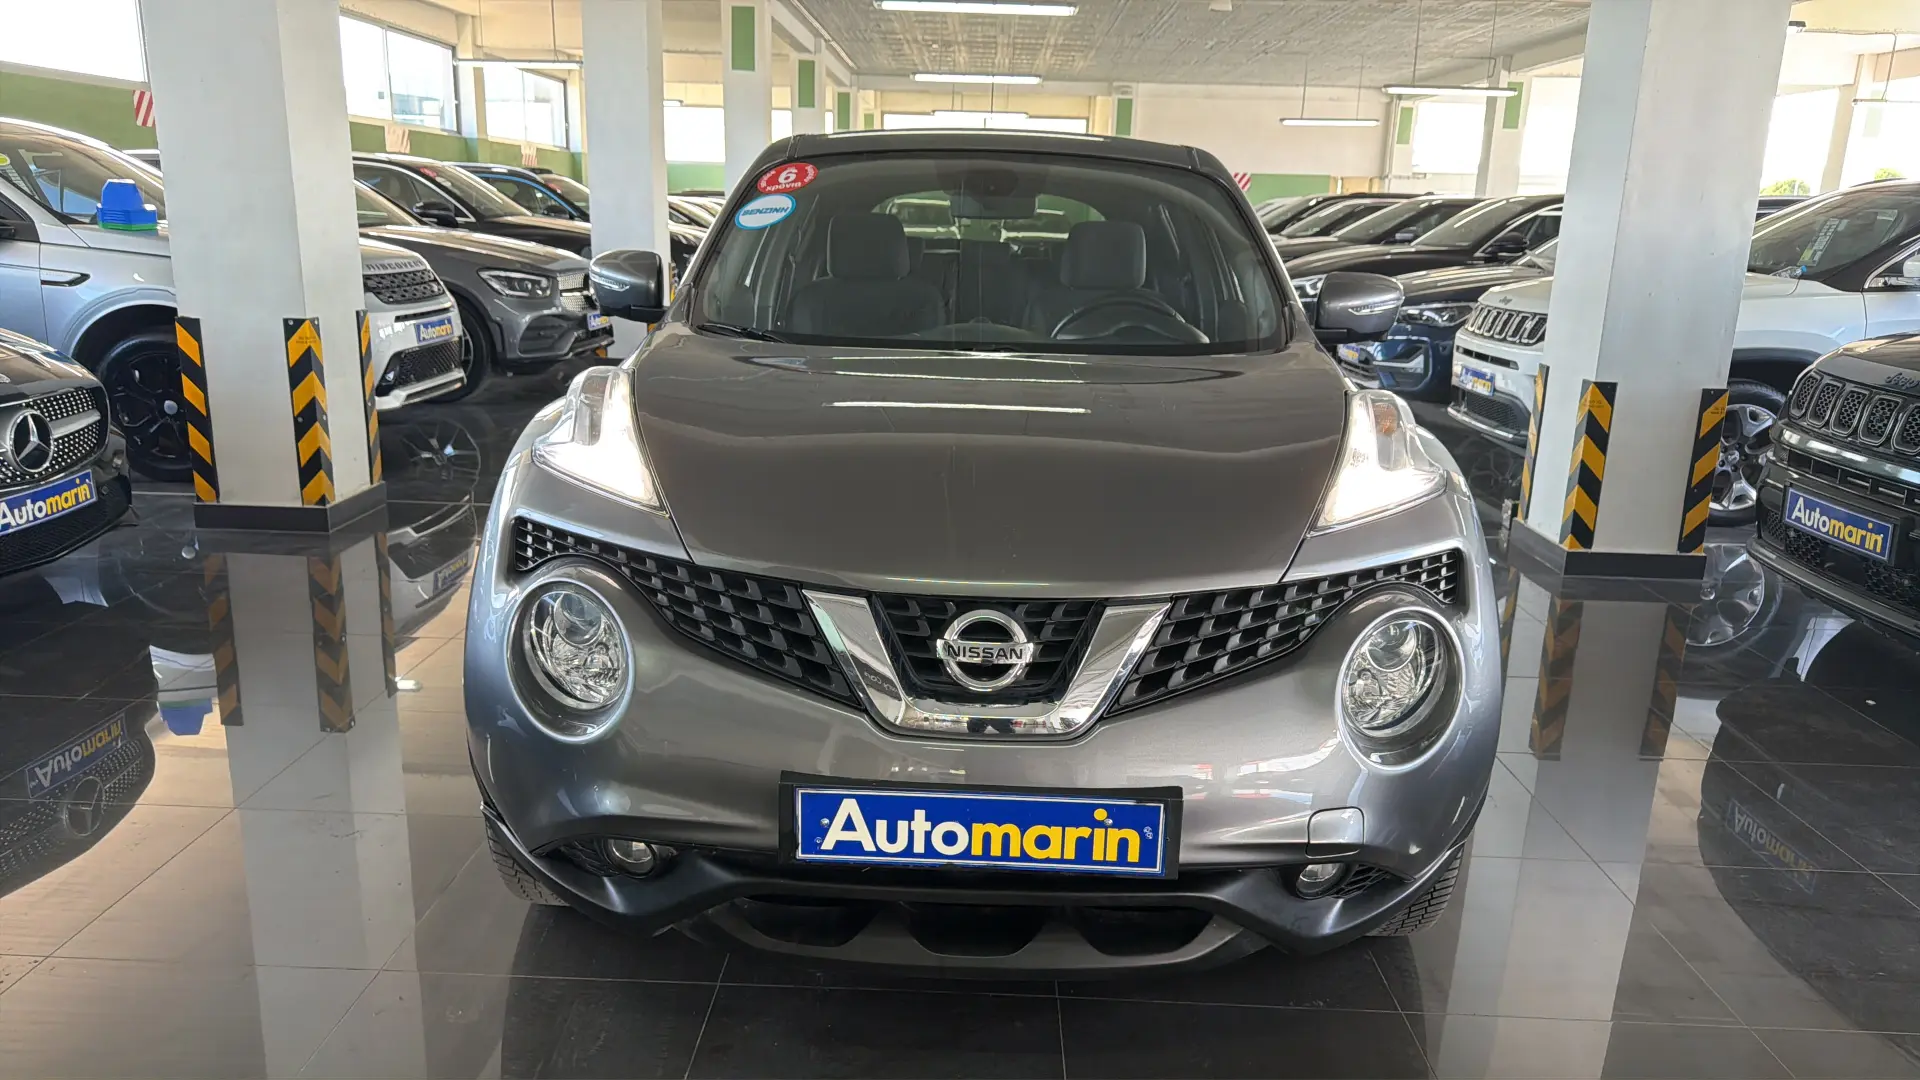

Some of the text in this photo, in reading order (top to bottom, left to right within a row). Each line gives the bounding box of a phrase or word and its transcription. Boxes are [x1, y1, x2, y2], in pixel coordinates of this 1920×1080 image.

[778, 167, 799, 184] 6
[0, 478, 91, 530] Automarin
[1791, 497, 1884, 553] Automarin
[946, 643, 1024, 661] NISSAN
[820, 797, 1141, 864] Automarin
